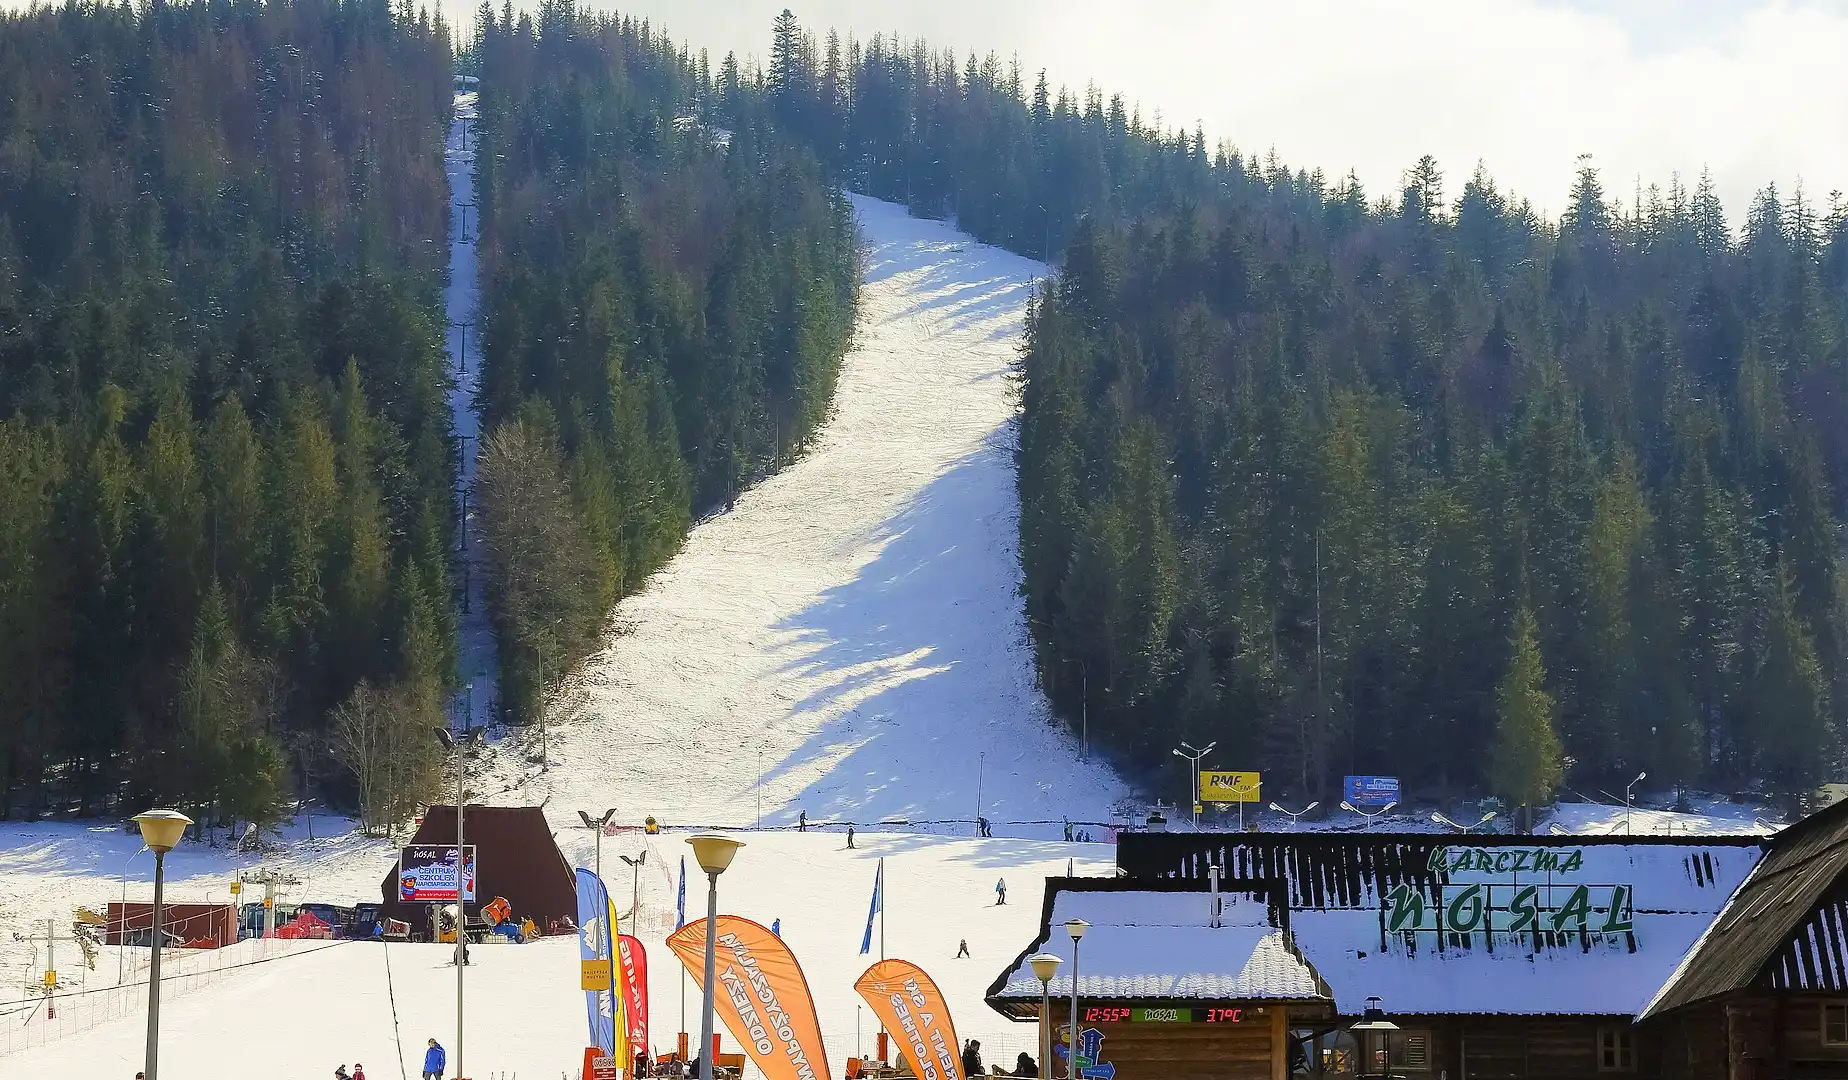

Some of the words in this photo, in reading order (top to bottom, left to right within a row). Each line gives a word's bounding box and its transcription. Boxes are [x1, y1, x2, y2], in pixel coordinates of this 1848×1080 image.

[1210, 775, 1242, 786] RMF
[413, 850, 436, 859] NOSAL
[1427, 848, 1583, 875] KARCZMA
[1385, 883, 1632, 934] NOSAL
[1085, 1008, 1120, 1022] 12:55
[1144, 1009, 1178, 1021] NOSAL
